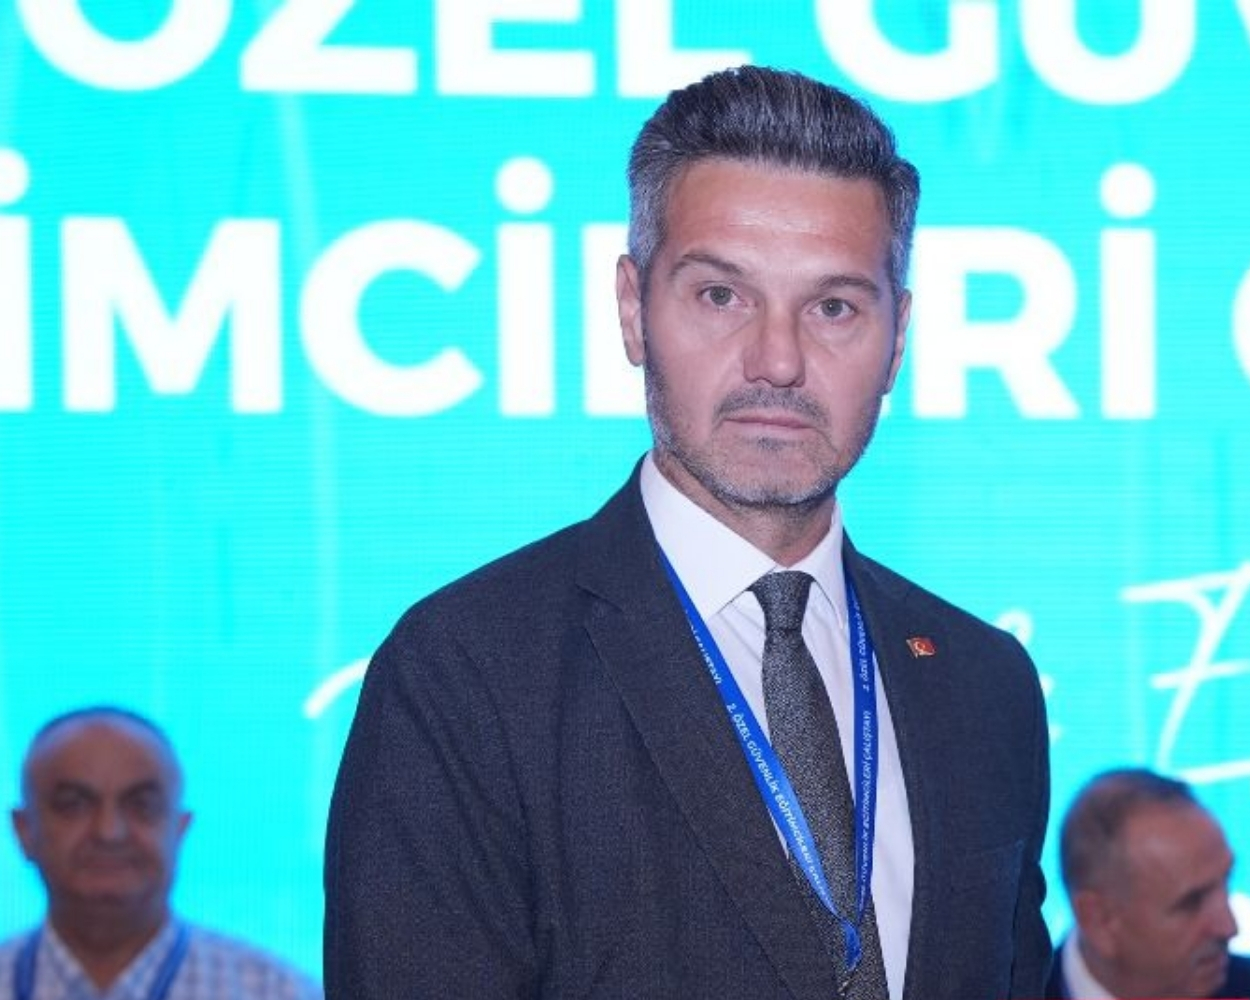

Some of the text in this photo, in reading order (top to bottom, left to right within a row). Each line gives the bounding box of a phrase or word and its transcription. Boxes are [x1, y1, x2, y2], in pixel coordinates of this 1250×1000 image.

[726, 702, 738, 714] 2.
[732, 712, 751, 741] ÖZEL
[747, 739, 780, 794] GÜVENLİK
